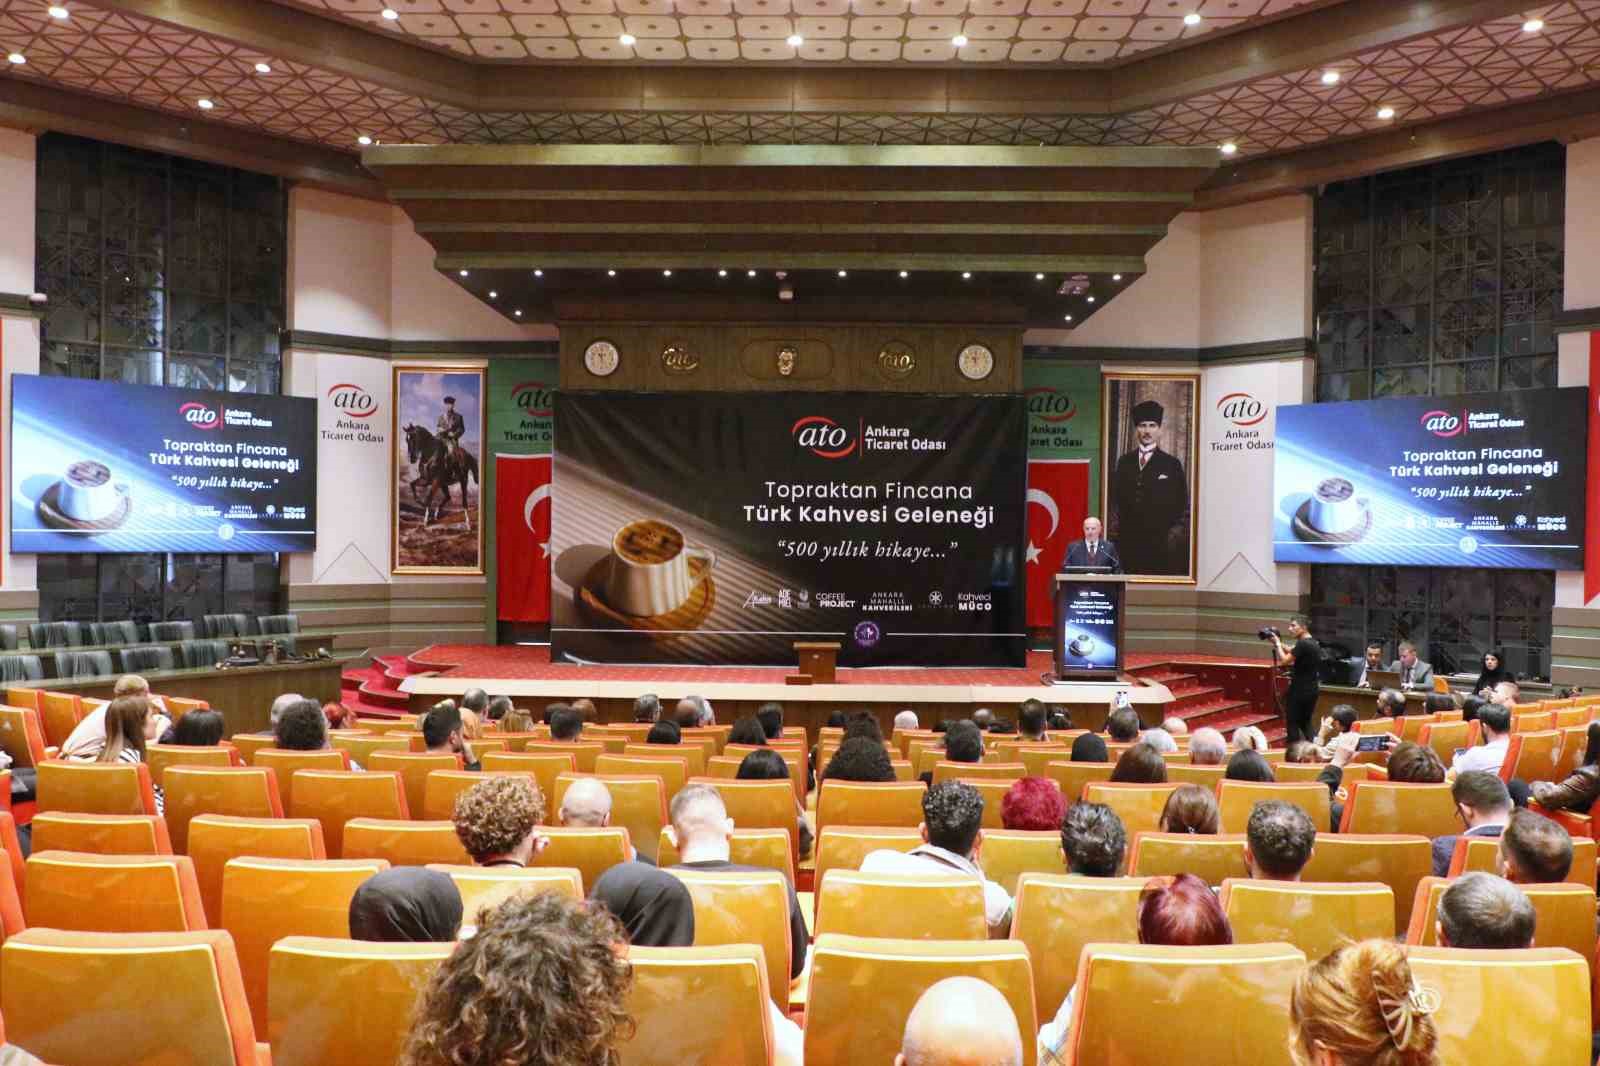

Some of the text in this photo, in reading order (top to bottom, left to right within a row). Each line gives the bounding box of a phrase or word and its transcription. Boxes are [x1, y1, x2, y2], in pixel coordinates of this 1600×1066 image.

[334, 391, 372, 410] ato
[1029, 394, 1070, 413] ato
[224, 409, 253, 418] Ankara
[1223, 399, 1262, 418] ato
[185, 407, 217, 423] ato
[1468, 412, 1500, 421] Ankara
[225, 417, 251, 426] Ticaret
[336, 419, 370, 431] Ankara
[1426, 414, 1459, 431] ato
[1468, 420, 1498, 429] Ticaret
[865, 425, 910, 437] Ankara
[1031, 423, 1068, 434] Ankara
[1225, 429, 1259, 439] Ankara
[320, 430, 384, 443] Ticaret Odası
[504, 431, 538, 441] Ticaret
[798, 424, 847, 448] ato
[1054, 436, 1083, 448] Odası
[163, 439, 288, 456] Topraktan Fincana
[865, 438, 946, 450] Ticaret Odası
[1210, 440, 1274, 452] Ticaret Odası
[1403, 447, 1543, 464] Topraktan Fincana
[150, 453, 300, 473] Türk Kahvesi Geleneği
[1389, 461, 1559, 477] Türk Kahvesi Geleneği
[765, 481, 973, 502] Topraktan Fincana
[1438, 485, 1470, 501] yıllık
[743, 505, 994, 528] Türk Kahvesi Geleneği
[819, 540, 869, 563] yıllık
[815, 592, 846, 601] COFFEE
[957, 591, 992, 601] Kahveci
[819, 600, 856, 608] PROJECT
[958, 600, 992, 611] MÜCO
